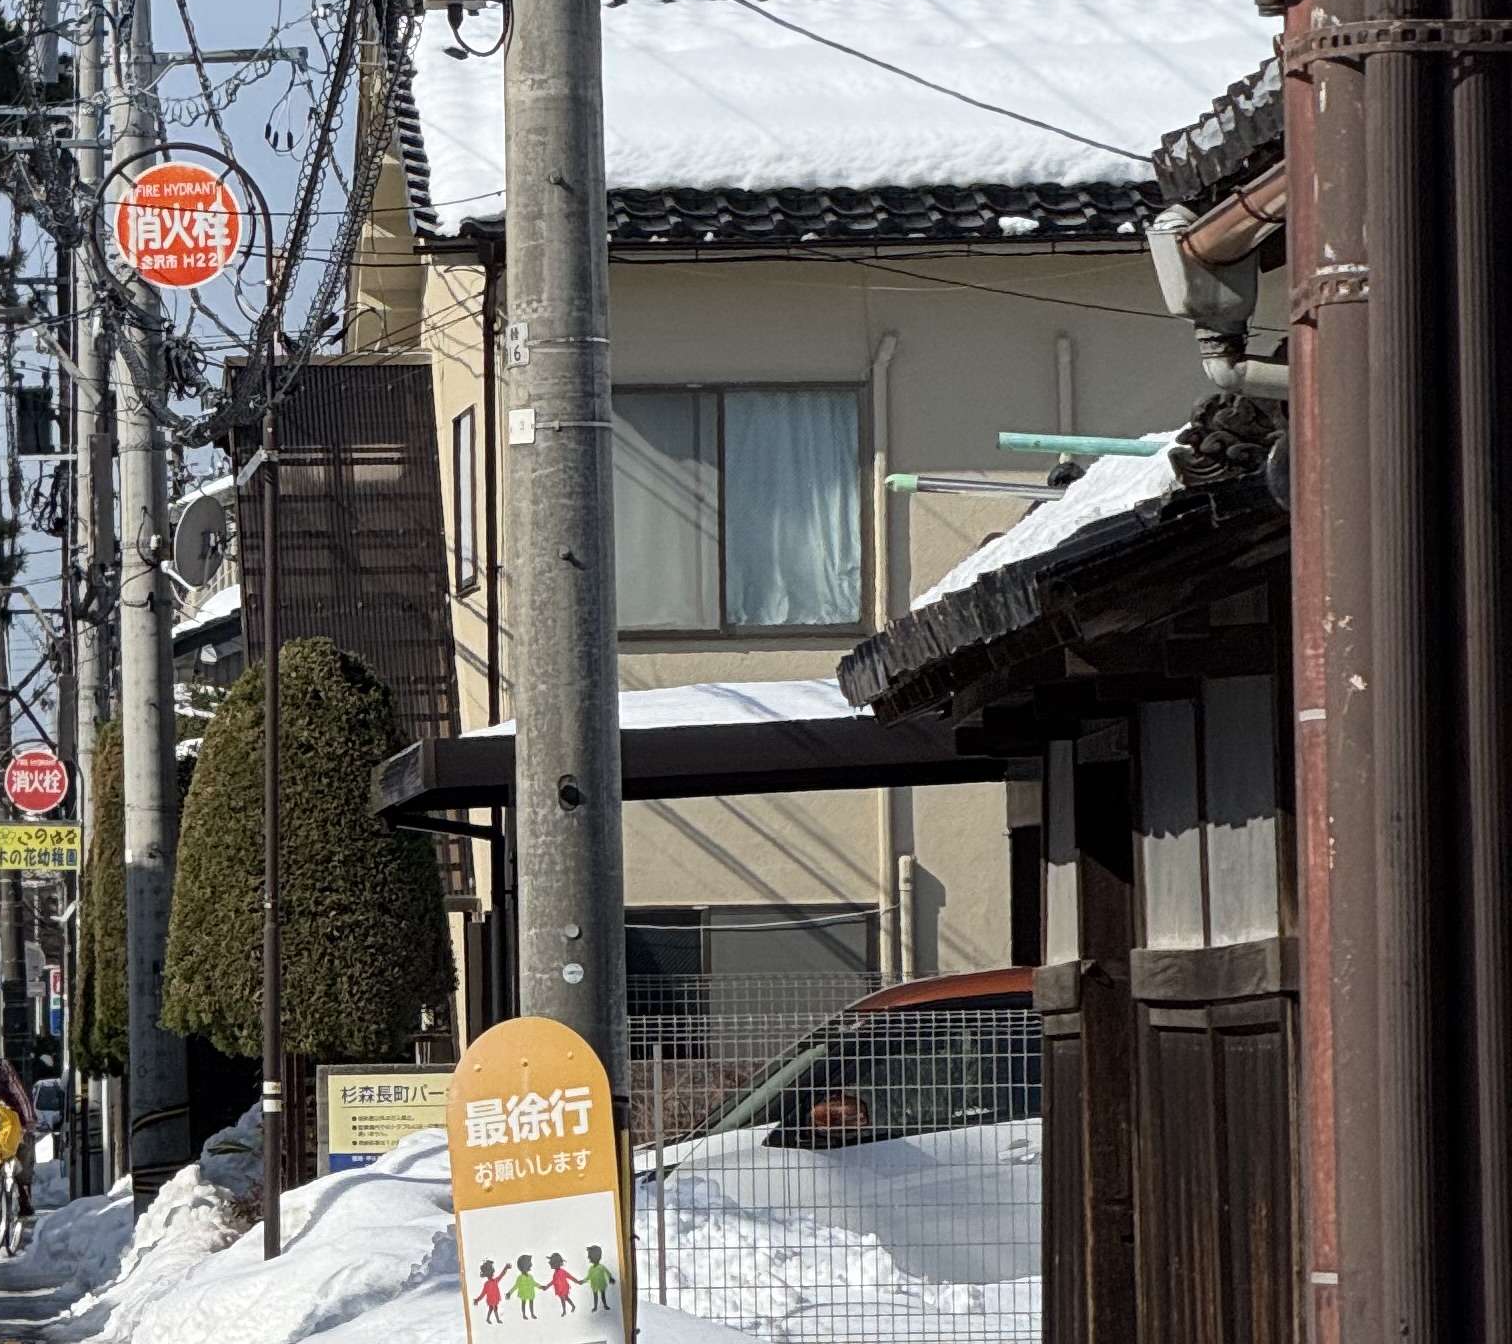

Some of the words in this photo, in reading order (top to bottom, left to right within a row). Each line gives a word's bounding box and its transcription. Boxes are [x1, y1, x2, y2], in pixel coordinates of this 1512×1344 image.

[137, 184, 160, 198] FIRE
[163, 181, 216, 197] HYDRANT
[128, 202, 231, 252] 消火栓
[141, 255, 178, 270] 金沢市
[183, 252, 218, 269] H22
[11, 769, 62, 794] 消火栓
[17, 828, 78, 846] このはな
[340, 1083, 451, 1104] 杉森長町パー
[464, 1086, 593, 1148] 最徐行
[474, 1149, 592, 1185] お願いします
